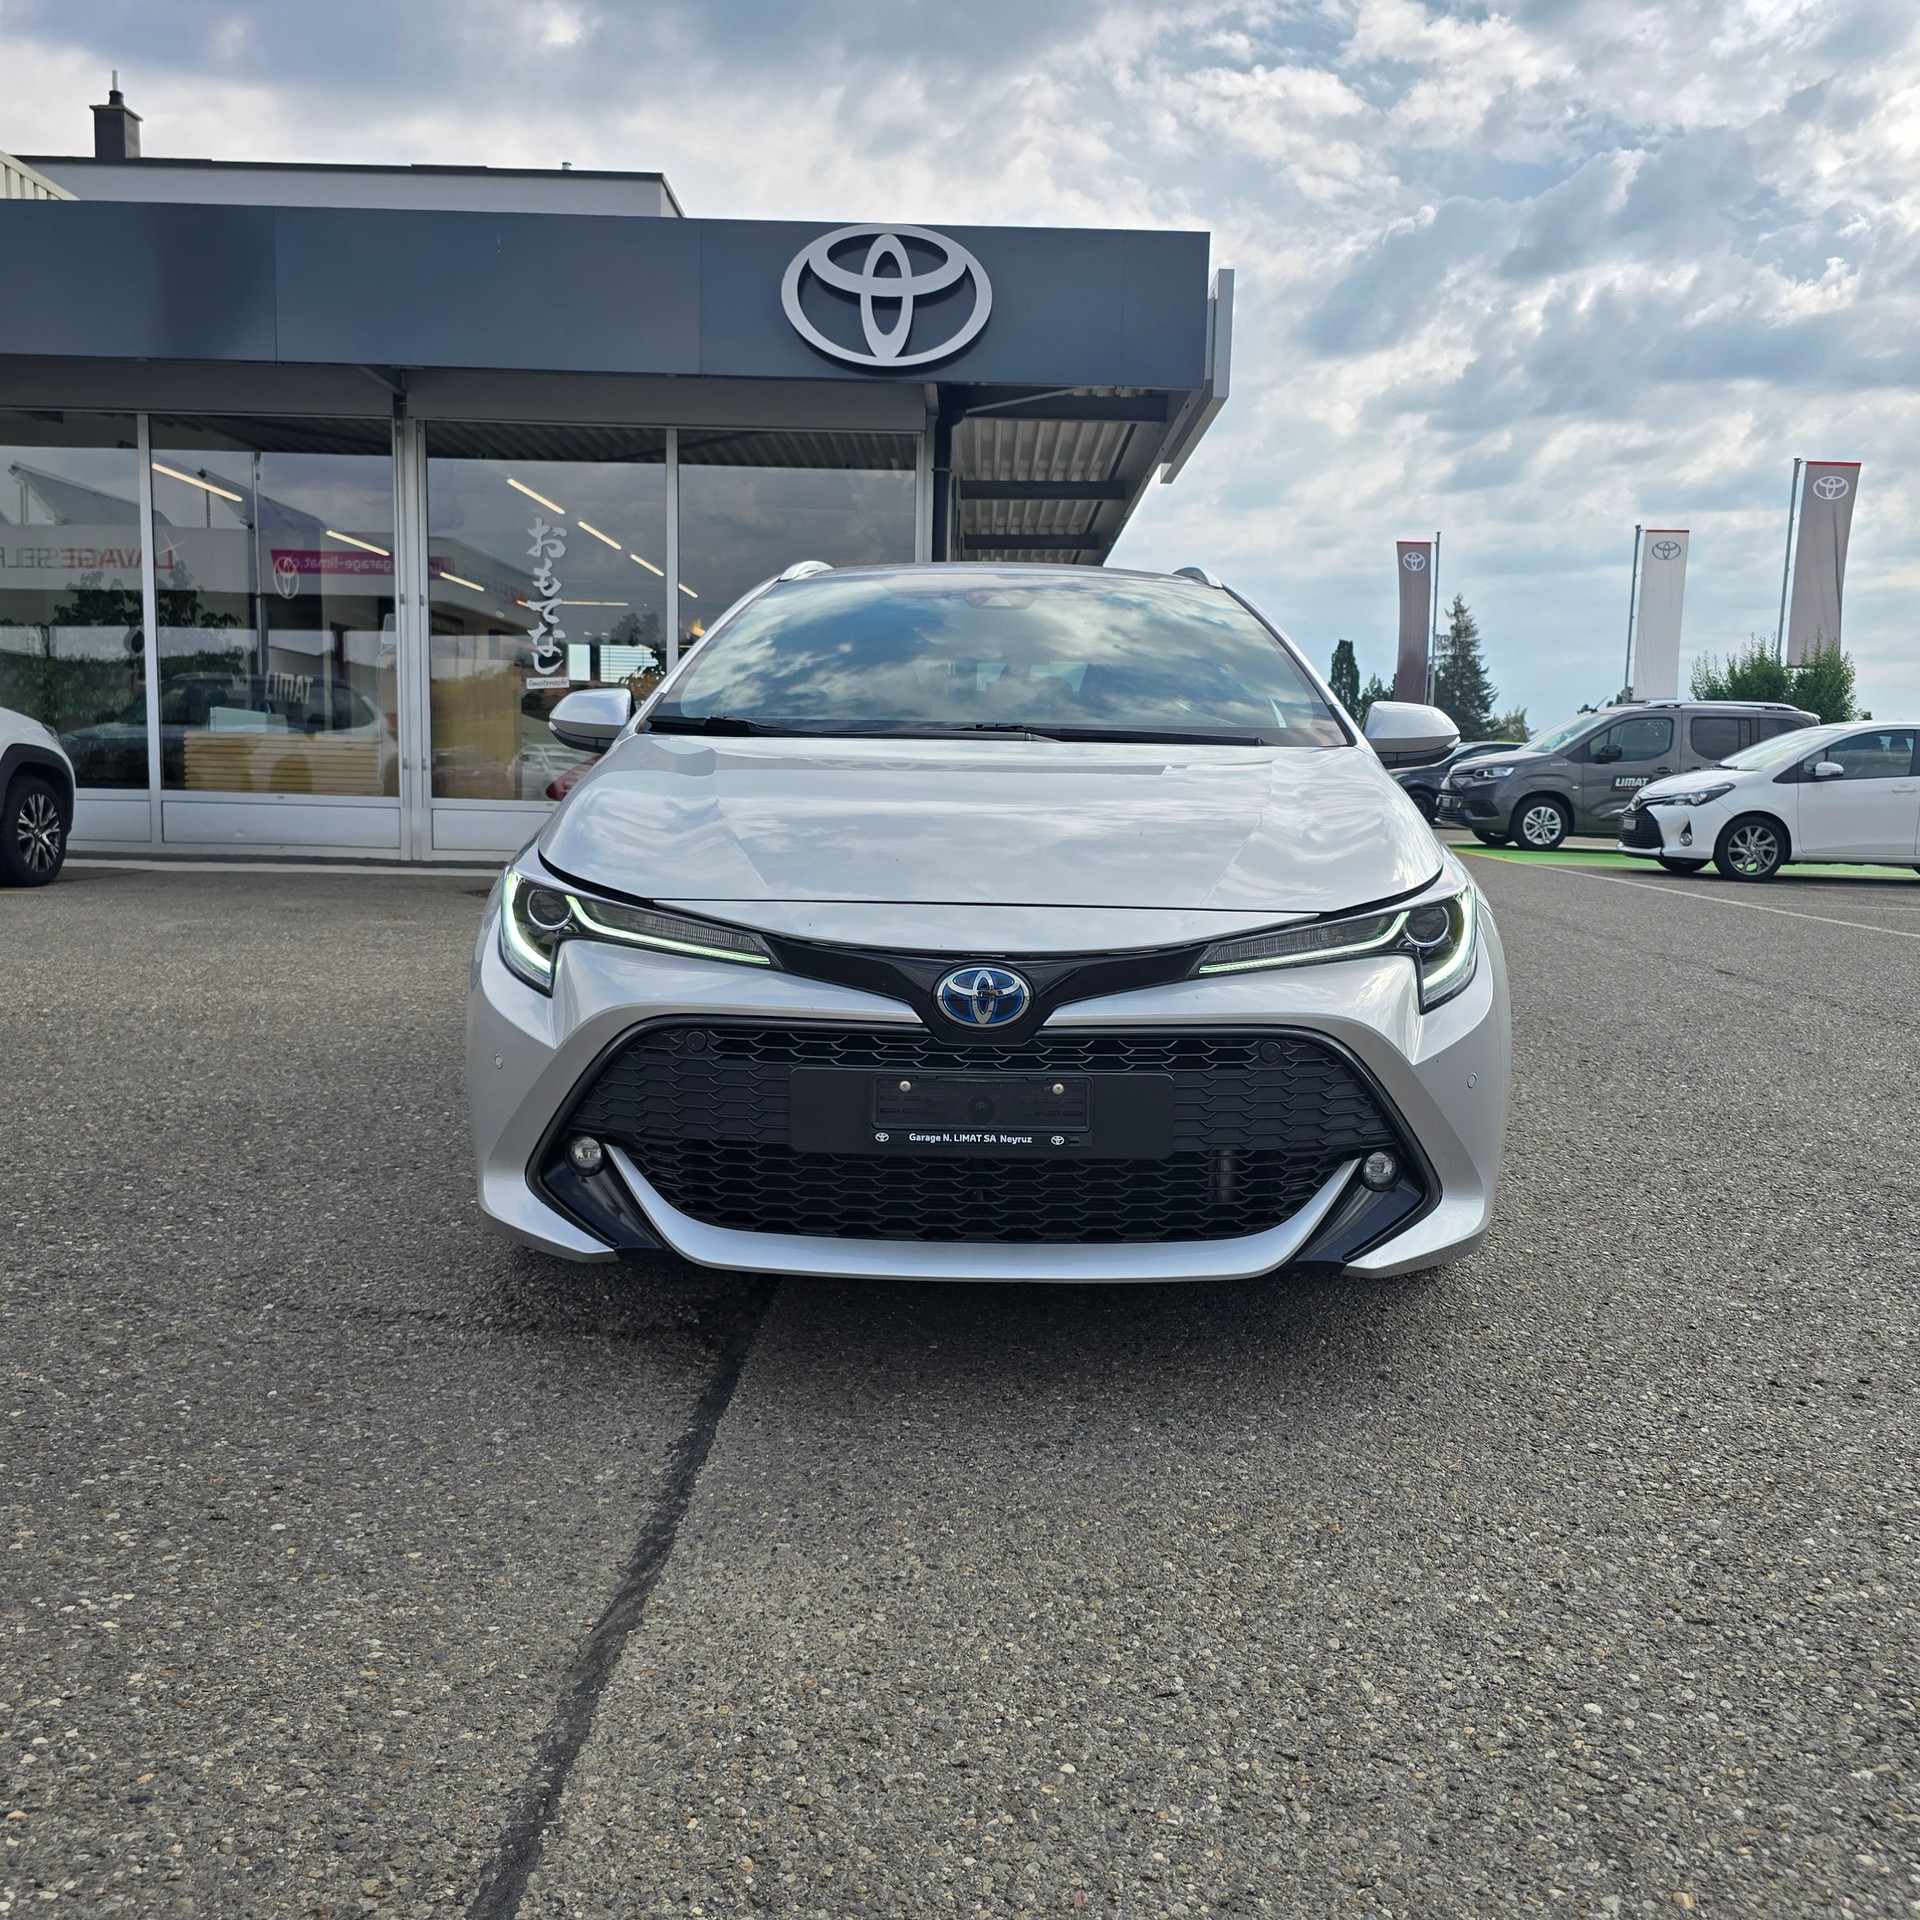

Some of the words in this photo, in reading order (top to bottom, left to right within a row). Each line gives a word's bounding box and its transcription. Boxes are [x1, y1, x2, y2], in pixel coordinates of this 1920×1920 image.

[526, 517, 568, 675] おもてなし
[265, 671, 313, 704] LIMAT
[1615, 777, 1649, 787] LIMAT
[908, 1132, 941, 1144] Garage
[942, 1134, 953, 1142] N.
[953, 1133, 982, 1143] LIMAT
[983, 1134, 997, 1143] SA
[1000, 1134, 1033, 1145] Neyruz
